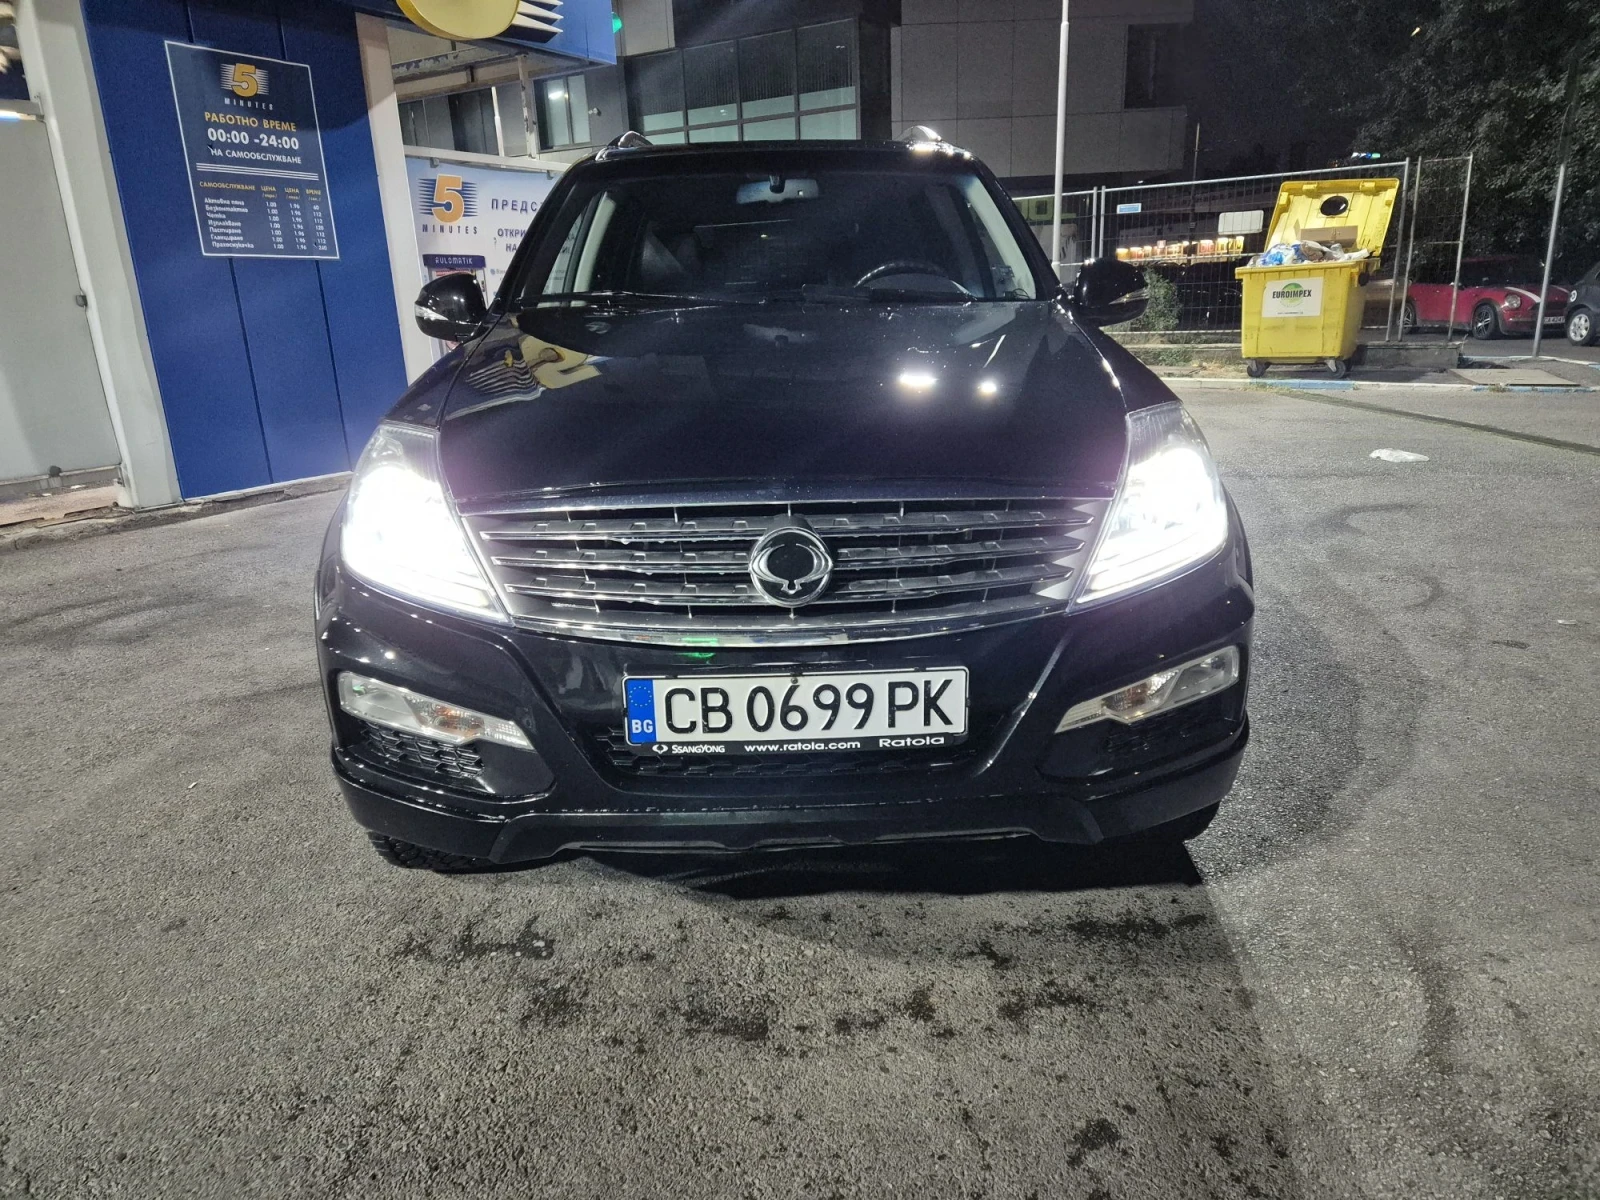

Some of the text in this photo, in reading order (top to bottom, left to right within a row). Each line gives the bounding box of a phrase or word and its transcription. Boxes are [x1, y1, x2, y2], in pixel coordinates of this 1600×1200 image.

[231, 63, 259, 97] 5
[224, 97, 274, 111] MINUTES
[204, 111, 297, 132] РАБОТНО ВРЕМЕ
[207, 128, 250, 145] 00:00
[211, 148, 302, 164] НА САМООБСЛУЖВАНЕ
[200, 181, 256, 191] САМООБСЛУЖВАНЕ
[432, 174, 465, 224] 5
[491, 198, 543, 214] ПРЕДС
[422, 224, 478, 235] MINUTES
[1272, 289, 1312, 299] EUROIMPEX
[664, 679, 953, 734] CB 0699 PK
[631, 719, 654, 734] BG
[744, 740, 861, 752] www.ratola.com
[879, 735, 945, 748] Ratola
